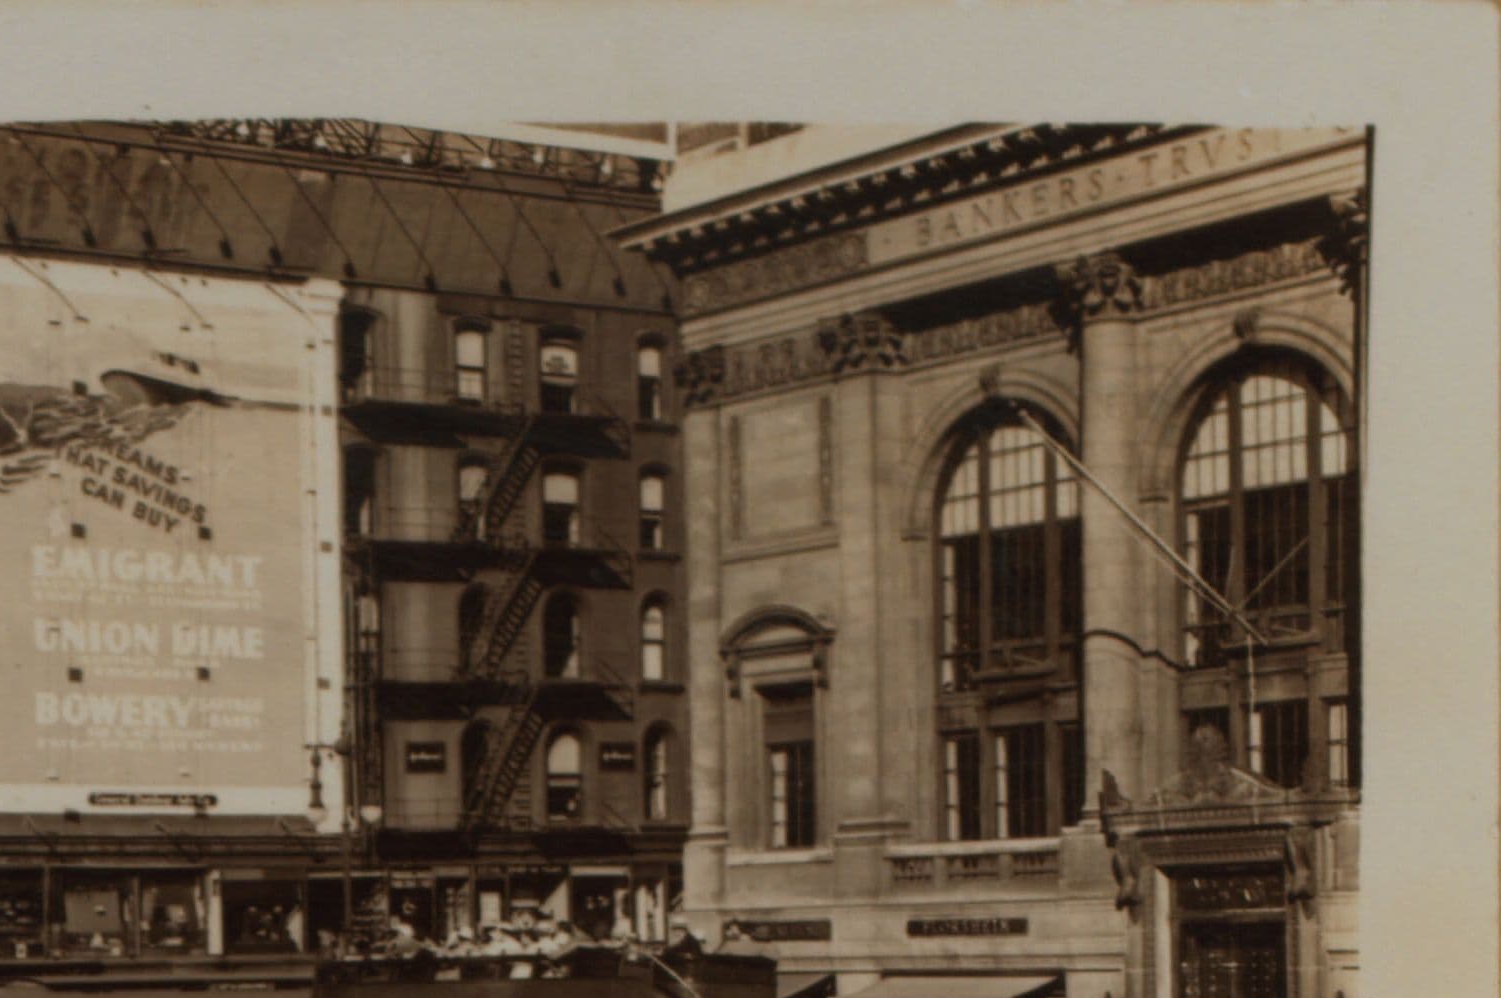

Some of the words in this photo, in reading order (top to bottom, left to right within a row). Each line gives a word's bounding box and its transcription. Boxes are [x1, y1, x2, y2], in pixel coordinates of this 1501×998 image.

[914, 168, 1106, 248] BANKERS
[80, 476, 126, 511] CAN
[132, 500, 180, 534] BUY
[112, 465, 207, 524] SAVINGS
[30, 544, 263, 589] EMIGRANT
[34, 617, 160, 656] UNION
[172, 624, 266, 660] DIME
[34, 691, 196, 728] BOWERY
